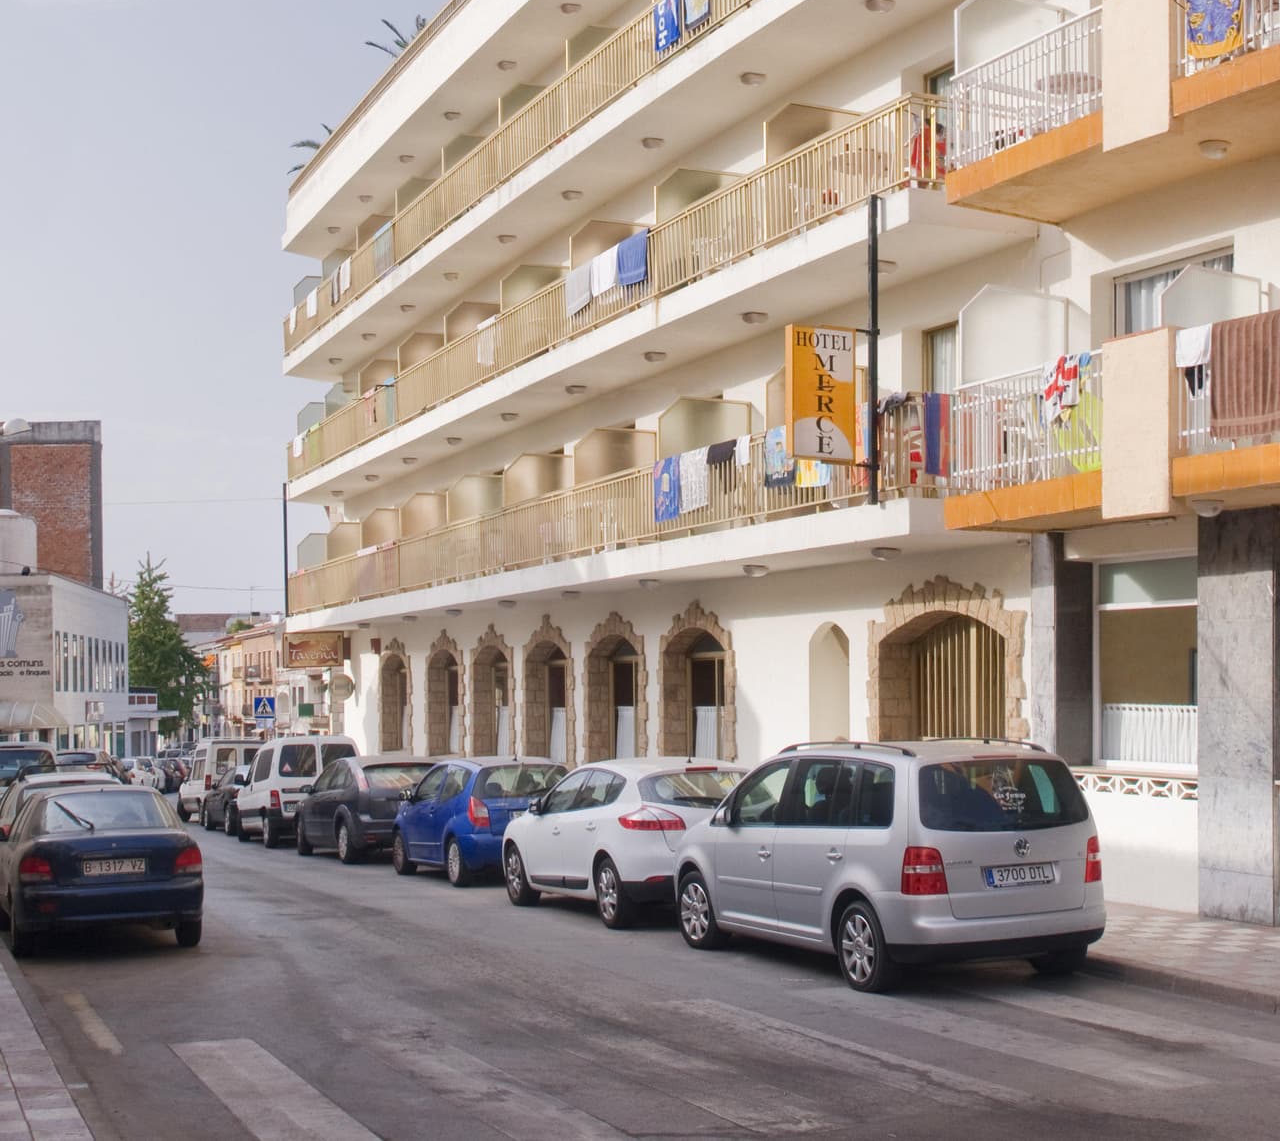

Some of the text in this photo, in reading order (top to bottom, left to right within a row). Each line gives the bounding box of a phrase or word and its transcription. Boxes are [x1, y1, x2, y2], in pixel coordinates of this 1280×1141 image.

[796, 330, 852, 352] HOTEL
[289, 649, 338, 661] Taverna
[7, 659, 44, 668] comuns
[997, 864, 1049, 882] 3700 DTL
